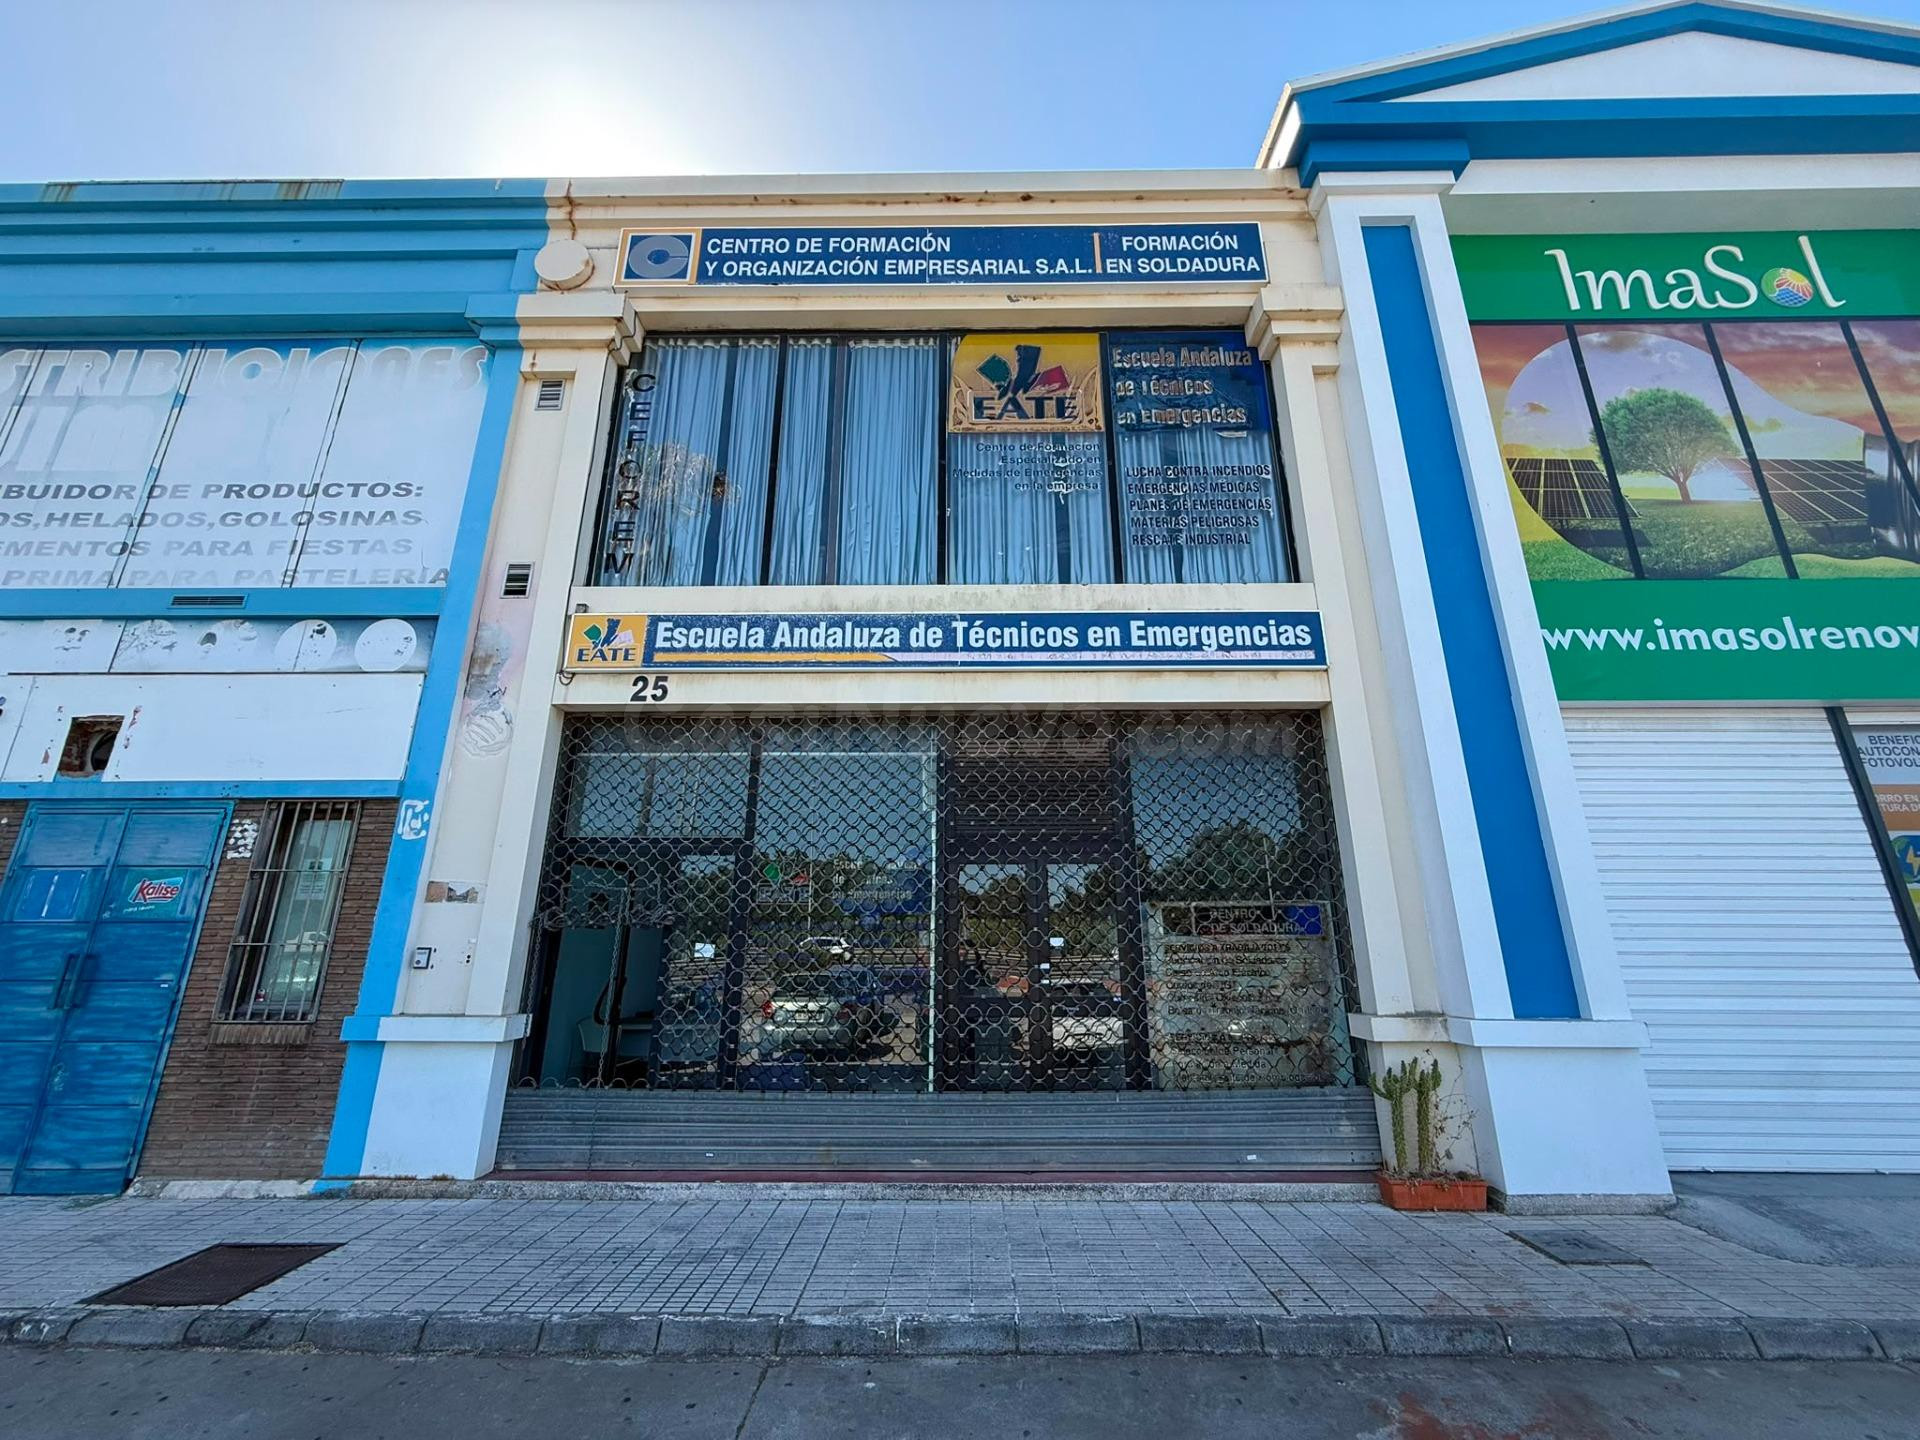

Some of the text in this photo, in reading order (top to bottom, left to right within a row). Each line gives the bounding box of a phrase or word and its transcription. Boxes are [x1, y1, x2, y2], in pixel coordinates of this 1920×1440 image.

[707, 233, 950, 254] CENTRO DE FORMACIÓN
[1122, 232, 1238, 251] FORMACIÓN
[705, 256, 1092, 276] Y ORGANIZACIÓN EMPRESARIAL S.A.L.
[1106, 257, 1260, 273] EN SOLDADURA
[1113, 346, 1252, 368] Escuela Andaluza
[973, 395, 1078, 420] EATE
[1117, 403, 1246, 427] en Emergencias
[976, 442, 1015, 452] Centro
[1019, 442, 1033, 451] de
[1001, 455, 1100, 466] Especializado en
[952, 468, 1101, 479] Medidas de Emergencias
[1126, 465, 1270, 477] LUCHA CONTRA INCENDIOS
[0, 482, 423, 500] BUIDOR DE PRODUCTOS:
[1015, 482, 1029, 490] en
[1033, 481, 1043, 490] la
[1128, 483, 1206, 494] EMERGENCIAS
[1130, 498, 1271, 511] PLANES DE EMERGENCIAS
[1131, 515, 1259, 527] MATERIAS PELIGROSAS
[1132, 533, 1250, 545] RESCATE INDUSTRIAL
[0, 538, 413, 557] MENTOS PARA FIESTAS
[2, 570, 115, 586] PRIMA
[128, 570, 219, 586] PARA
[654, 620, 1312, 651] Escuela Andaluza de Técnicos en Emergencias
[576, 648, 636, 662] EATE
[630, 675, 668, 702] 25
[133, 878, 179, 902] Kalise
